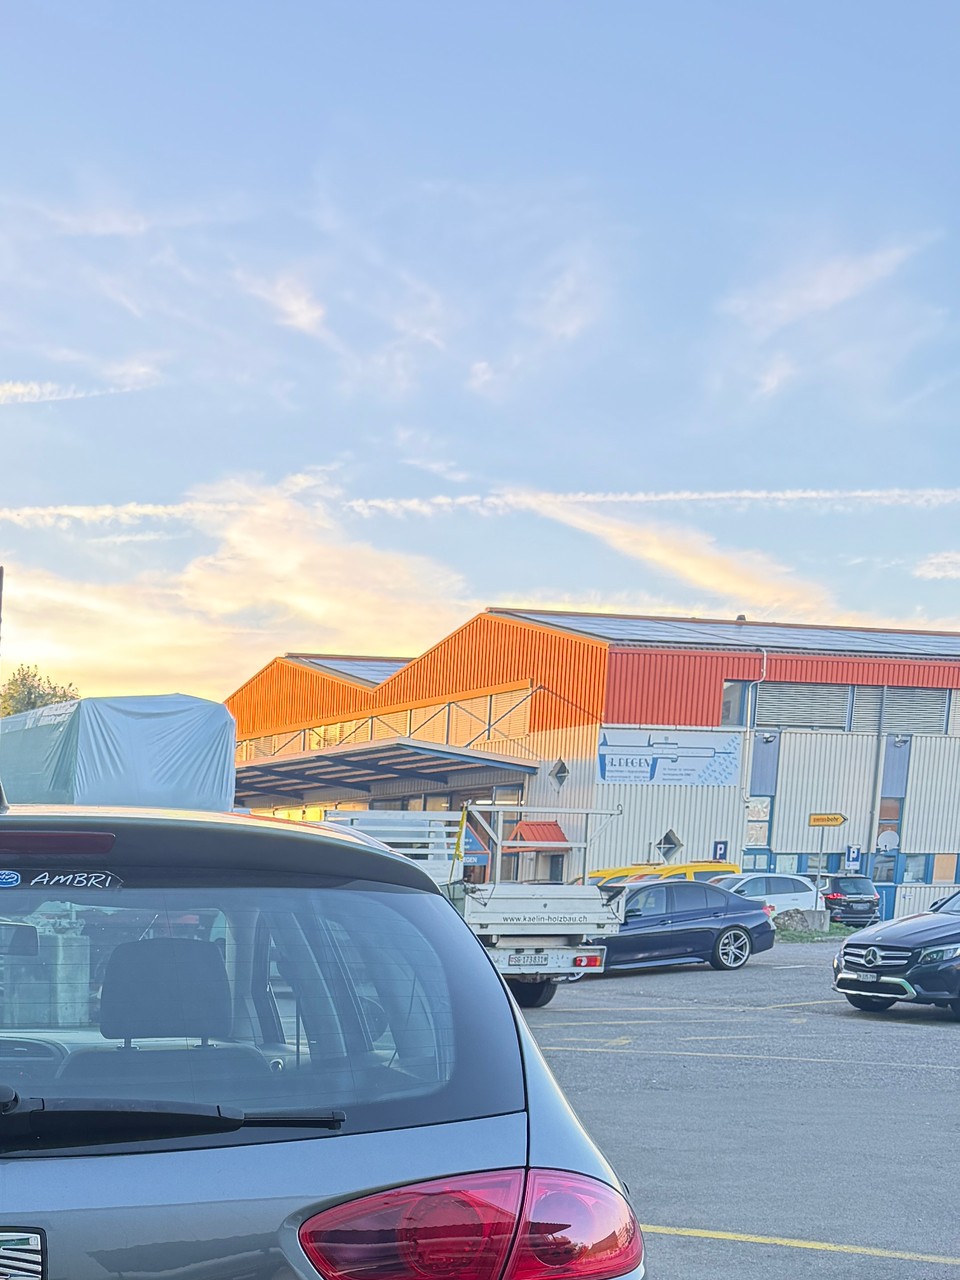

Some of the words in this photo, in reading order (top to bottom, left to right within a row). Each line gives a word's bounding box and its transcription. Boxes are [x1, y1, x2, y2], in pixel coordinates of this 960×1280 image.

[618, 757, 650, 768] DEGEN
[717, 844, 725, 859] P
[463, 856, 478, 864] EGEN
[30, 872, 112, 889] AMBRI
[502, 915, 588, 923] www.kaelin-holzbau.ch
